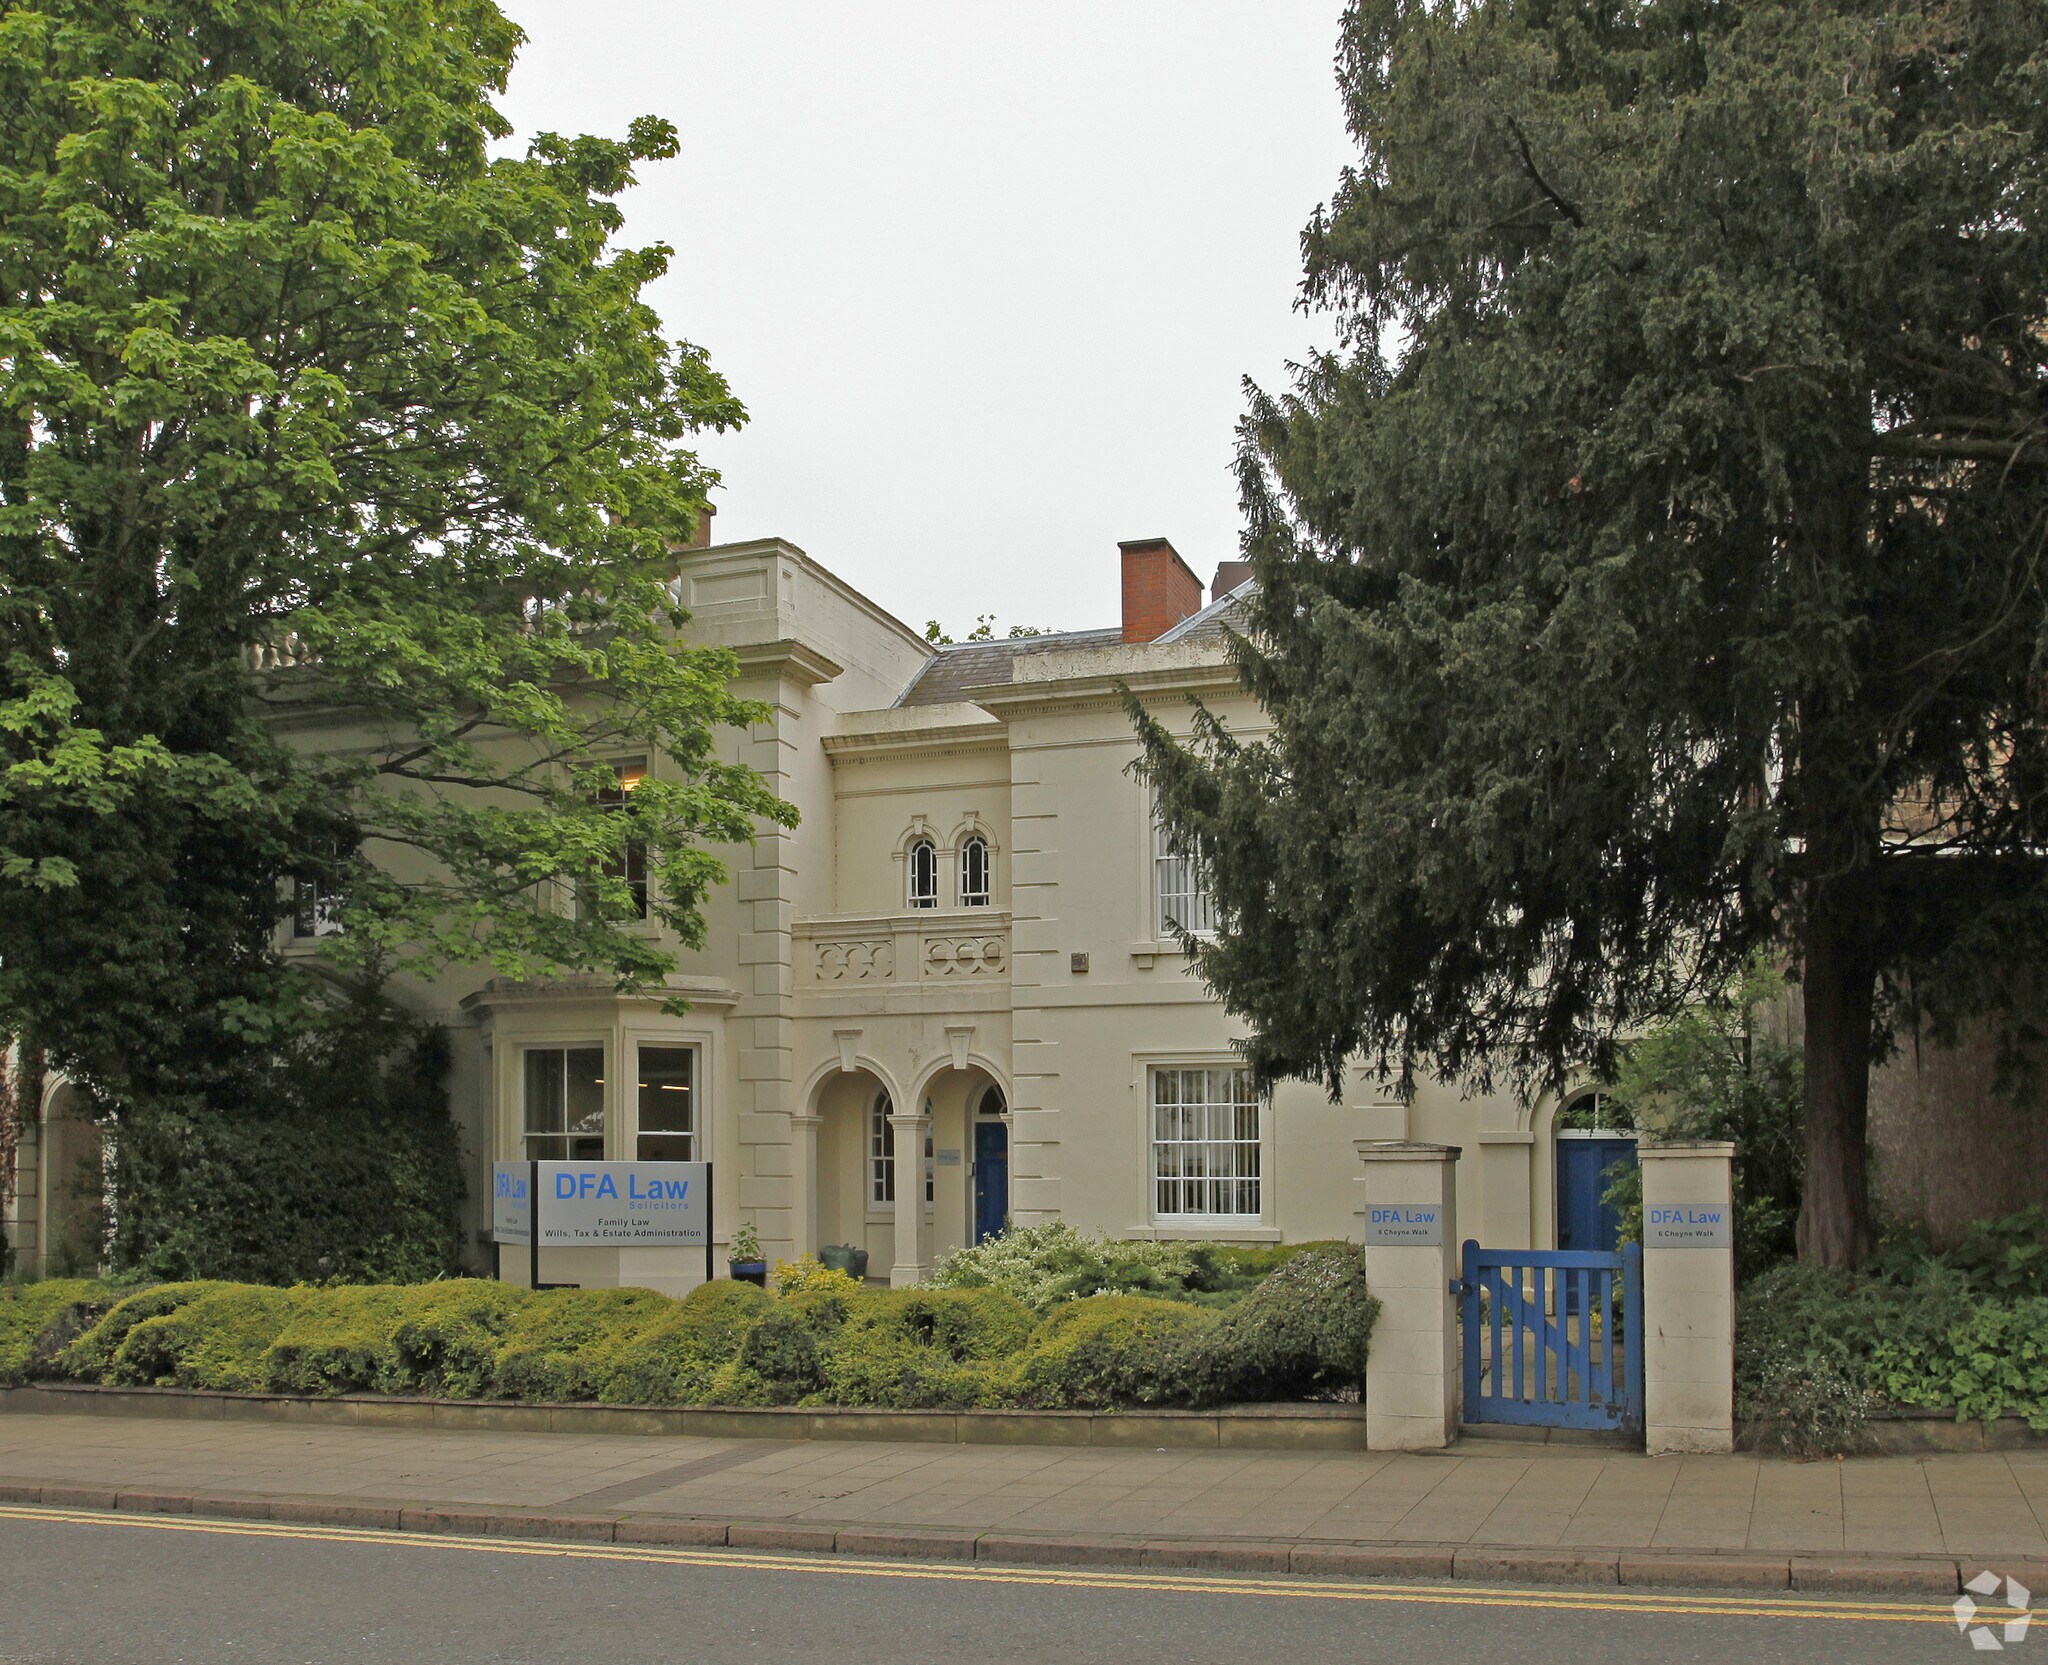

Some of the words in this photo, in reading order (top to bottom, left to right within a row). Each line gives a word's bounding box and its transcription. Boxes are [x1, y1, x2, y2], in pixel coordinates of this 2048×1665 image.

[496, 1173, 511, 1198] DFA
[511, 1173, 527, 1199] Law
[556, 1172, 619, 1200] DFA
[629, 1173, 689, 1200] Law
[629, 1201, 689, 1210] Solicitors
[1371, 1210, 1401, 1223] DFA
[1406, 1210, 1435, 1223] Law
[1651, 1210, 1683, 1223] DFA
[1688, 1210, 1721, 1223] Law
[598, 1218, 629, 1228] Family
[631, 1218, 650, 1226] Law
[545, 1229, 571, 1238] Wills,
[575, 1229, 590, 1237] Tax
[593, 1229, 600, 1237] &
[603, 1229, 632, 1237] Estate
[634, 1229, 701, 1238] Administration
[1384, 1229, 1410, 1237] Cheyne
[1664, 1230, 1693, 1238] Cheyne
